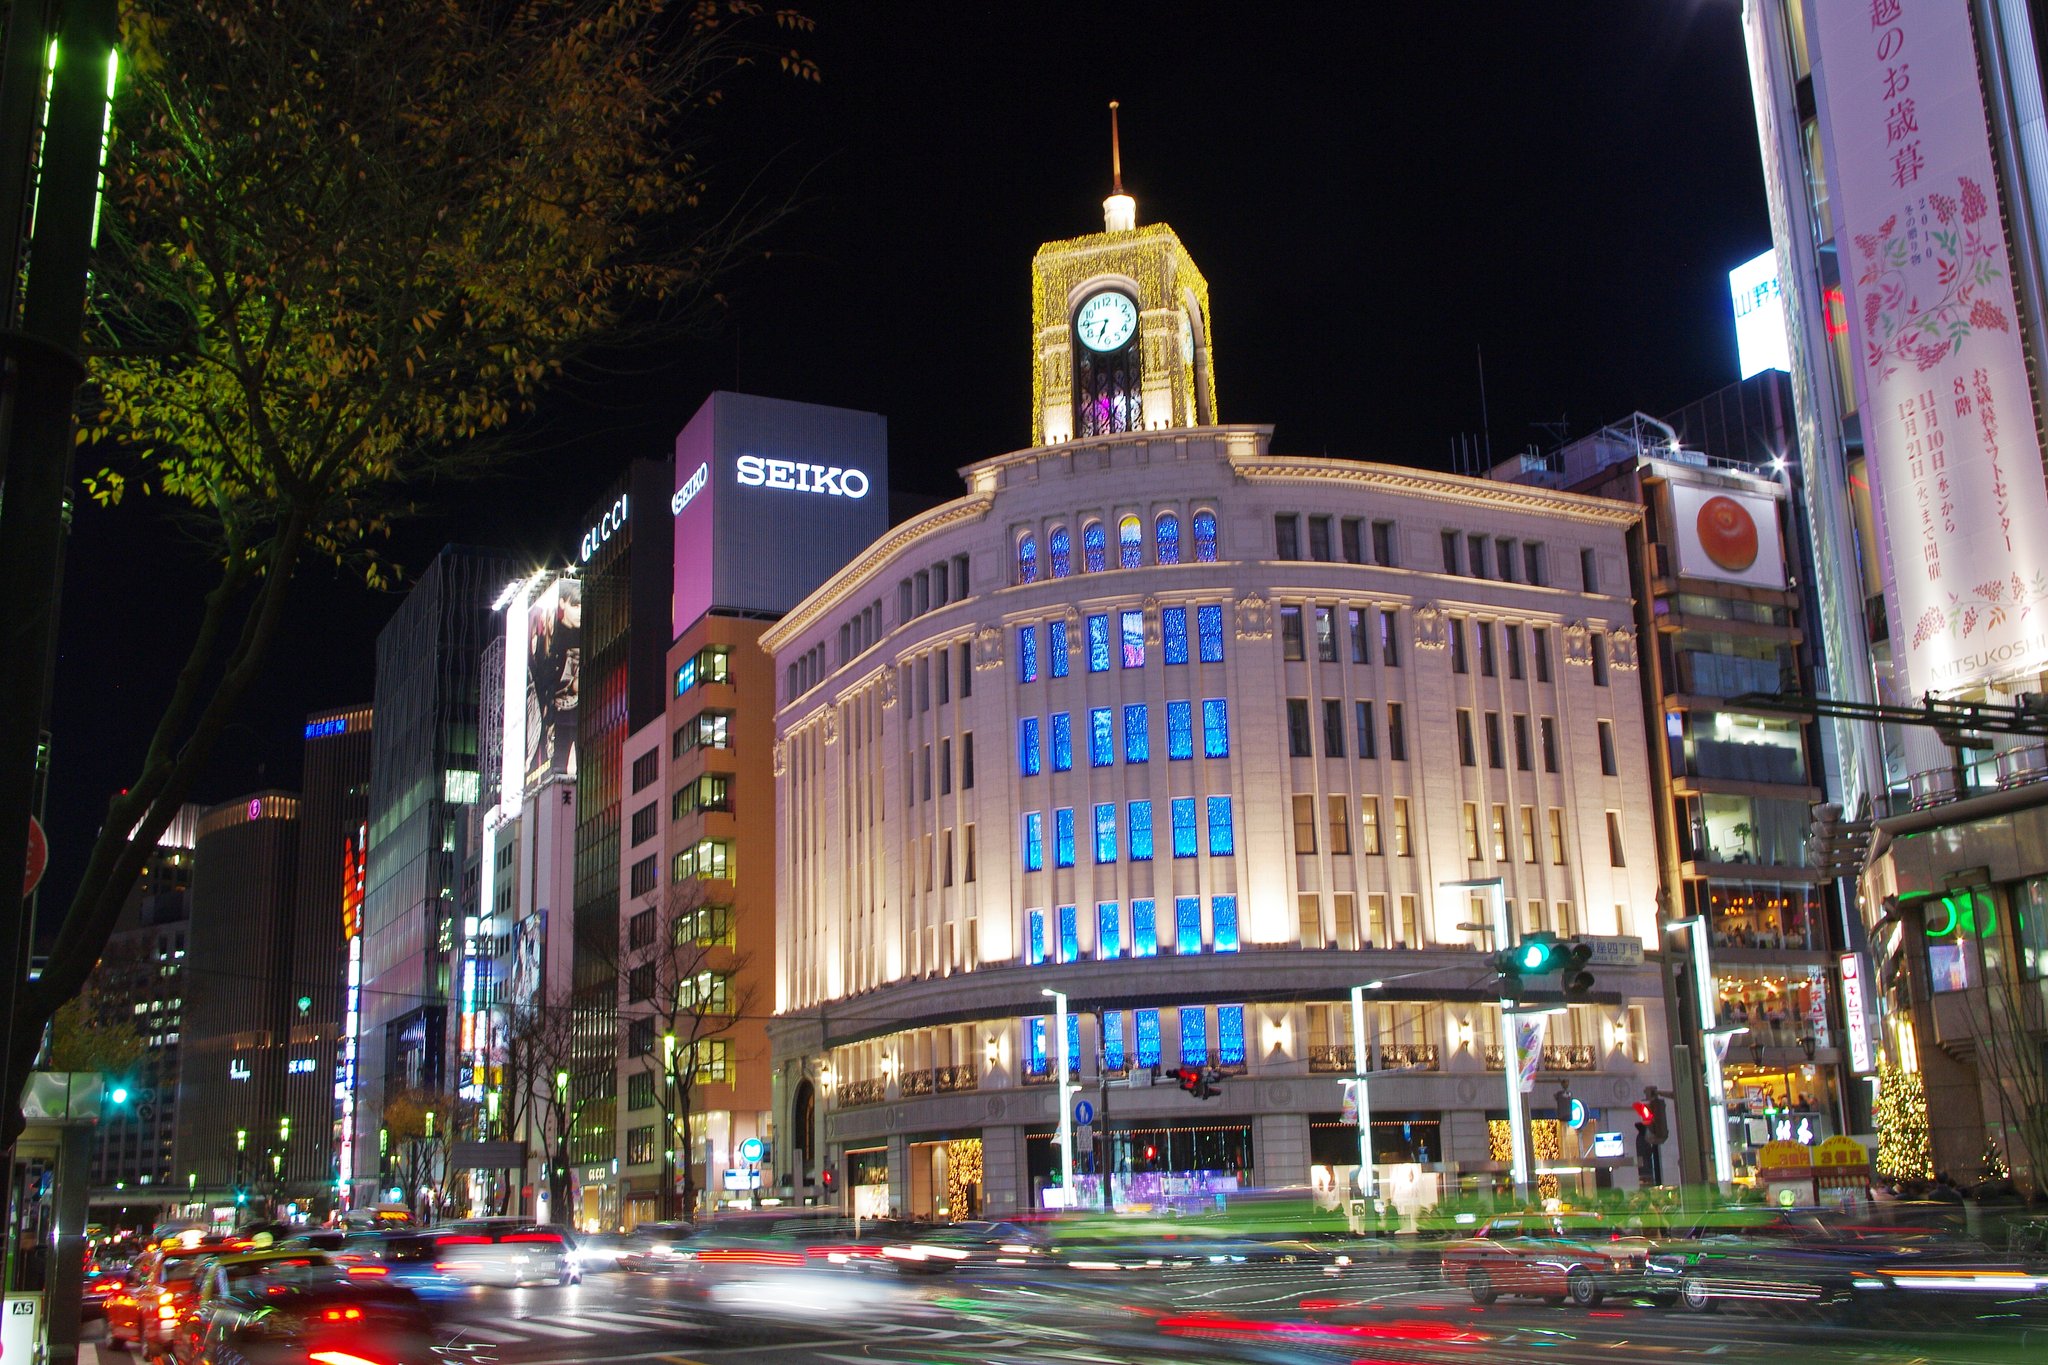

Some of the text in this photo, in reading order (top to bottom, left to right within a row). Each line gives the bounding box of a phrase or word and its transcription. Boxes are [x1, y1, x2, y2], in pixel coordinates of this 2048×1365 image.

[1919, 198, 1932, 258] 2010
[1085, 309, 1094, 319] 10
[1102, 296, 1111, 307] 12
[1953, 376, 1972, 418] 8階
[736, 454, 870, 500] SEIKO
[1973, 367, 2012, 553] お歳暮ギフトセンター
[671, 462, 708, 516] SEIKO
[581, 493, 629, 563] GUCCI
[1930, 634, 2047, 681] MITSUKOSHI
[14, 1302, 33, 1315] A5
